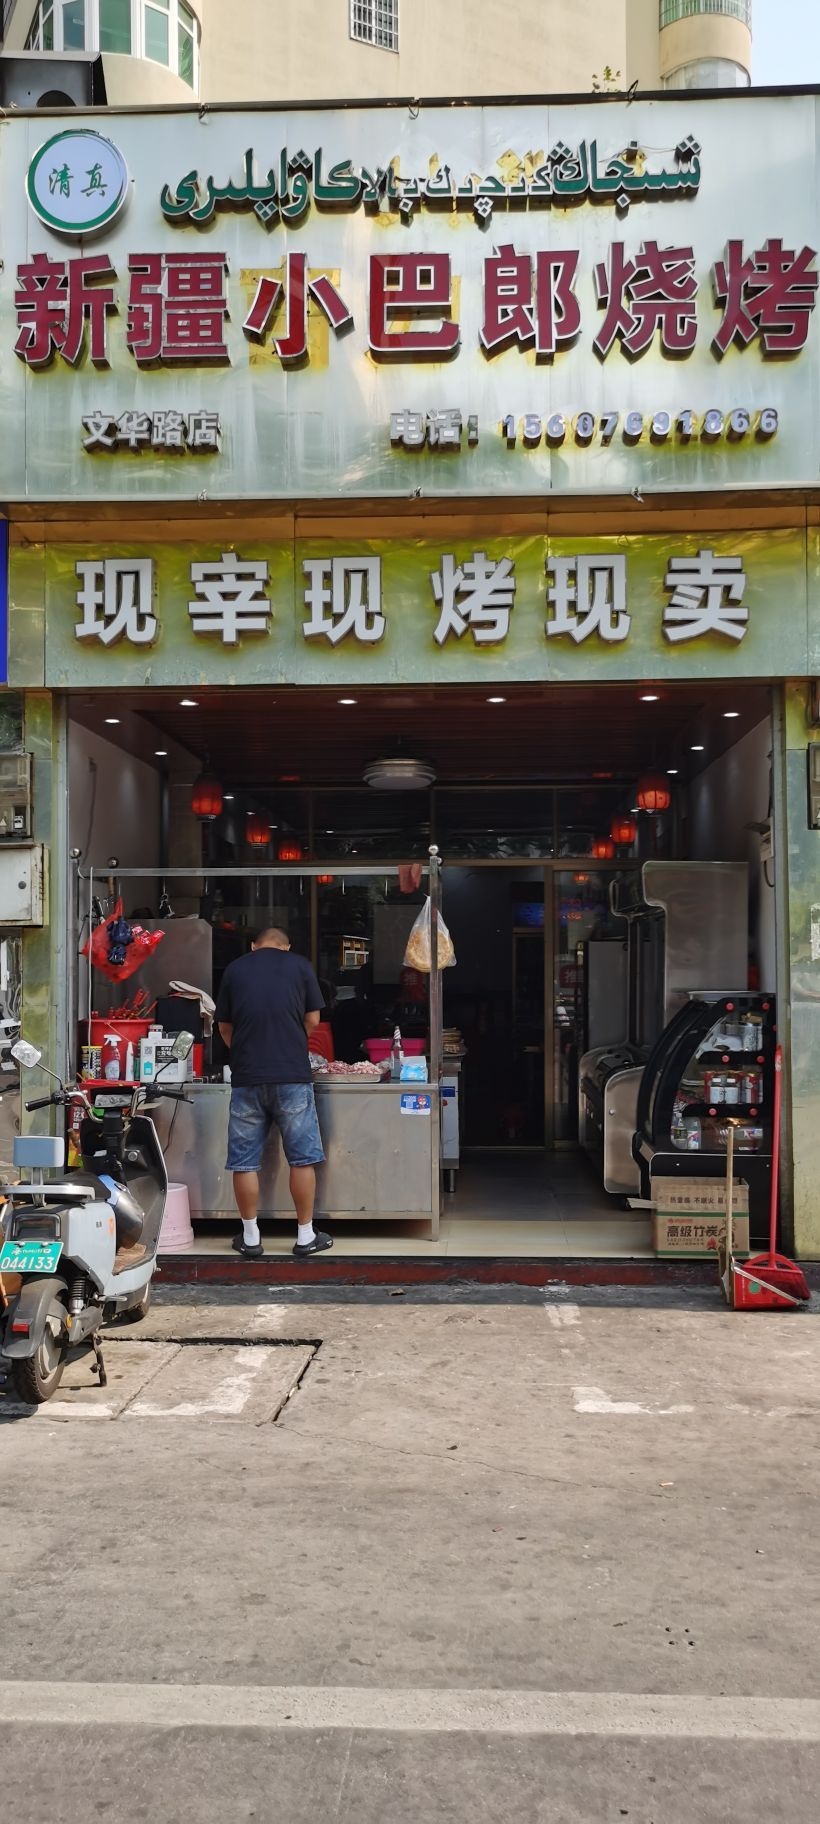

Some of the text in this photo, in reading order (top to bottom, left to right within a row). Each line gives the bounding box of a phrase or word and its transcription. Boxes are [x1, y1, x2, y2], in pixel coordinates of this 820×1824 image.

[49, 163, 108, 198] 清真
[13, 237, 819, 362] 新疆小巴郎烧烤
[82, 410, 219, 450] 文华路店
[667, 1225, 718, 1238] 高级竹炭
[1, 1256, 54, 1270] 044133
